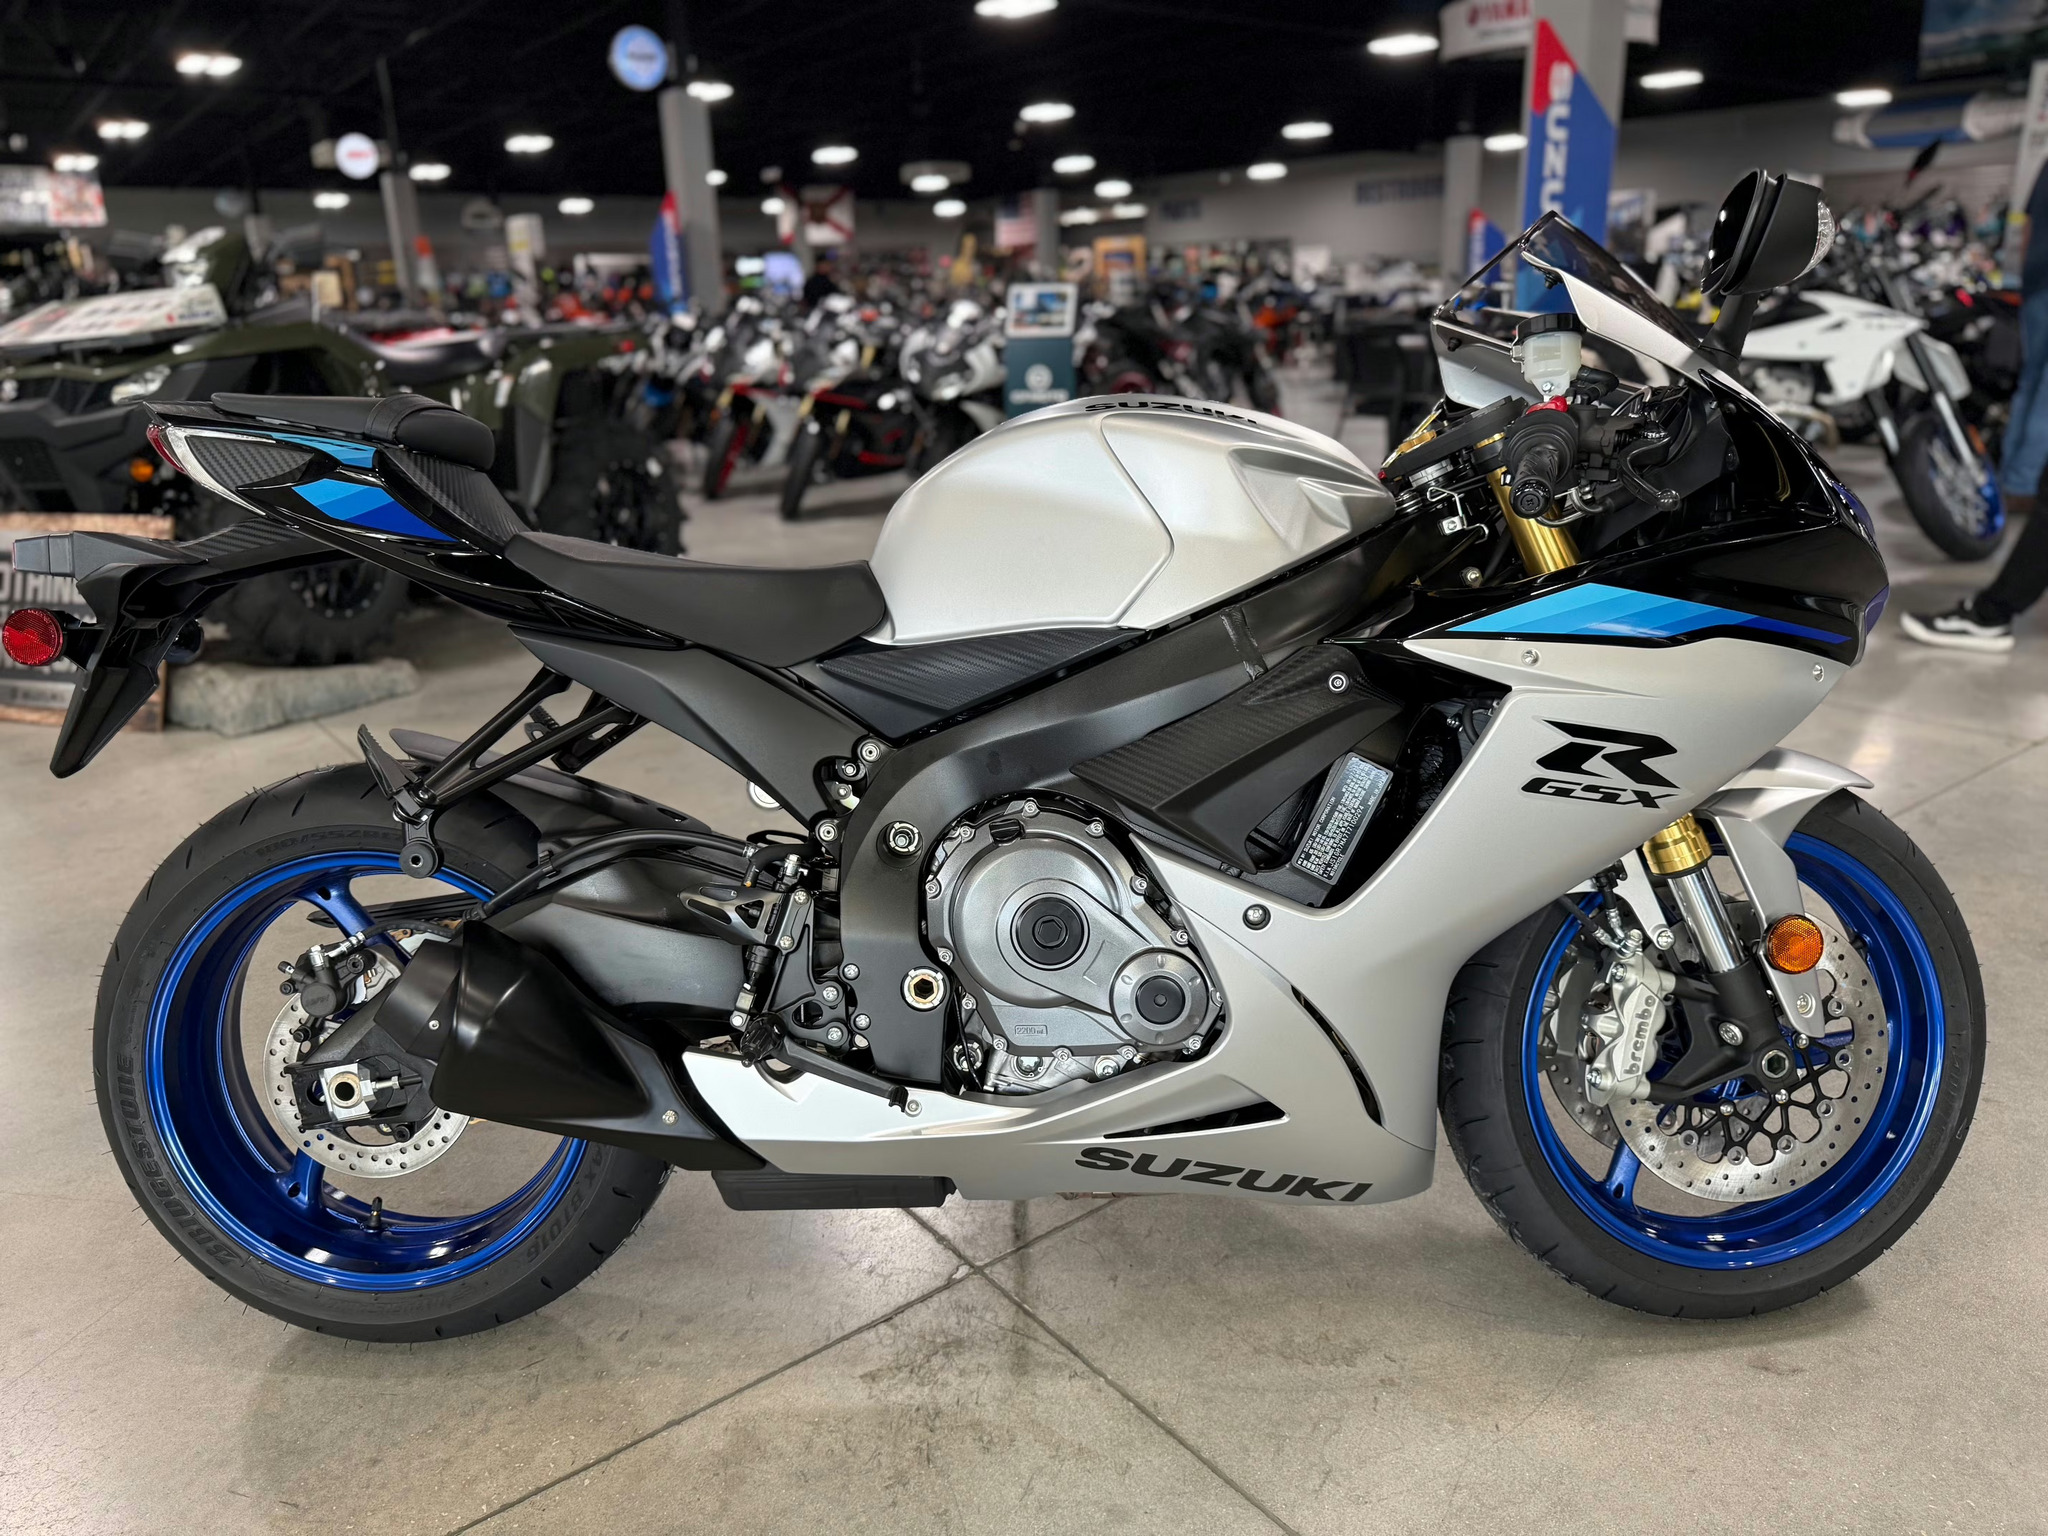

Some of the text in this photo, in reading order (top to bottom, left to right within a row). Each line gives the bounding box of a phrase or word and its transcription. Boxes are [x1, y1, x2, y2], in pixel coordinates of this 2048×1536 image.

[1536, 719, 1681, 789] R
[1521, 777, 1679, 809] GSX
[1623, 995, 1656, 1075] brembo
[116, 1051, 240, 1266] BRIDGESTONE
[1075, 1146, 1374, 1202] SUZUKI
